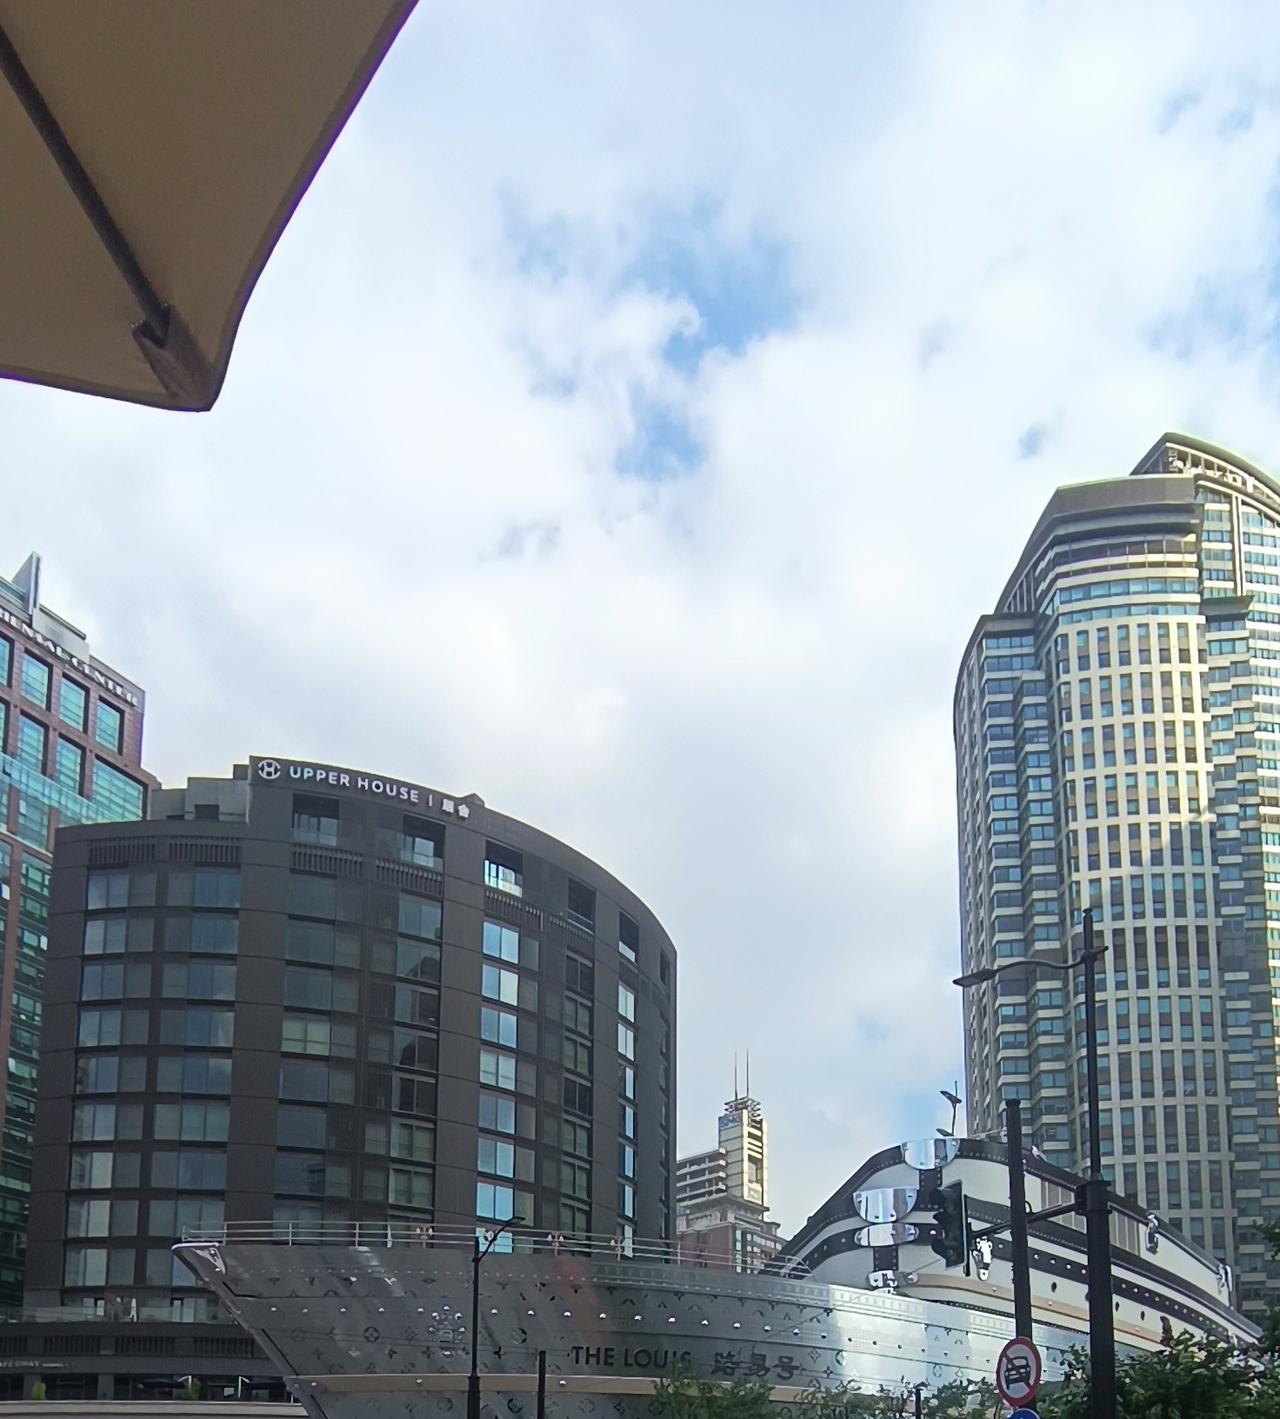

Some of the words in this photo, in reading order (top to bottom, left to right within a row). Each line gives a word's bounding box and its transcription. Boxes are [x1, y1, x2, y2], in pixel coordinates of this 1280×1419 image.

[289, 765, 350, 787] UPPER
[357, 776, 419, 803] HOUSE
[571, 1345, 615, 1367] THE
[711, 1350, 800, 1380] 路易号
